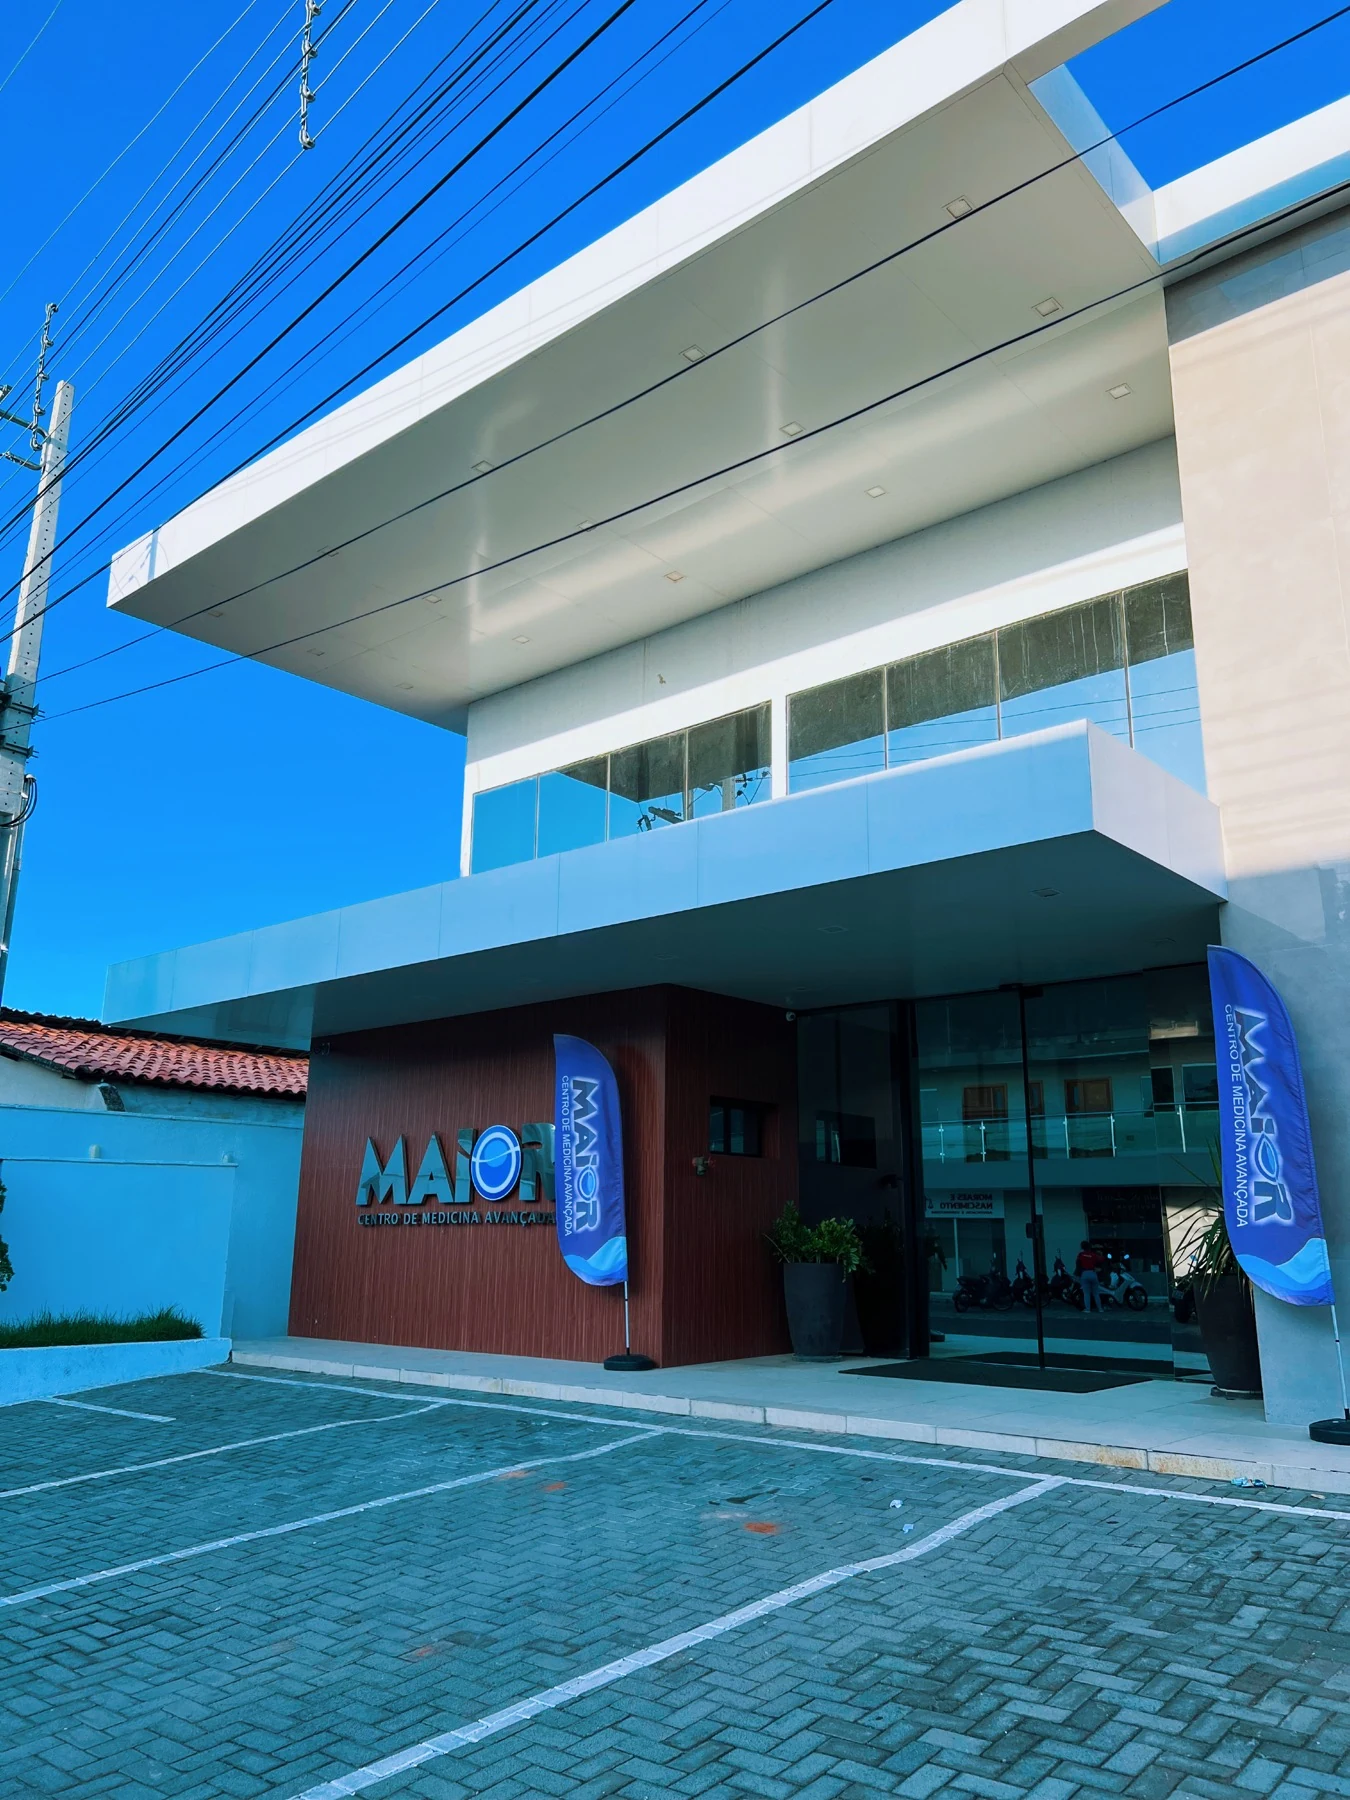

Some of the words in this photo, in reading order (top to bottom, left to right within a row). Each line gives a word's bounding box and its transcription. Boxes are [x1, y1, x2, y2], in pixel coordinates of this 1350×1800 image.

[1224, 1004, 1239, 1060] CENTRO
[561, 1075, 570, 1116] CENTRO
[1230, 1063, 1242, 1082] DE
[561, 1117, 571, 1132] DE
[1232, 1085, 1246, 1151] MEDICINA
[1234, 1009, 1293, 1223] MAIOR
[355, 1122, 555, 1206] MAIOR
[562, 1133, 572, 1181] MEDICINA
[571, 1078, 600, 1232] MAIOR
[563, 1182, 573, 1237] AVANÇADA
[1234, 1153, 1249, 1228] AVANÇADA
[357, 1211, 399, 1226] CENTRO
[403, 1211, 418, 1225] DE
[421, 1210, 479, 1225] MEDICINA
[484, 1210, 556, 1227] AVANÇADA
